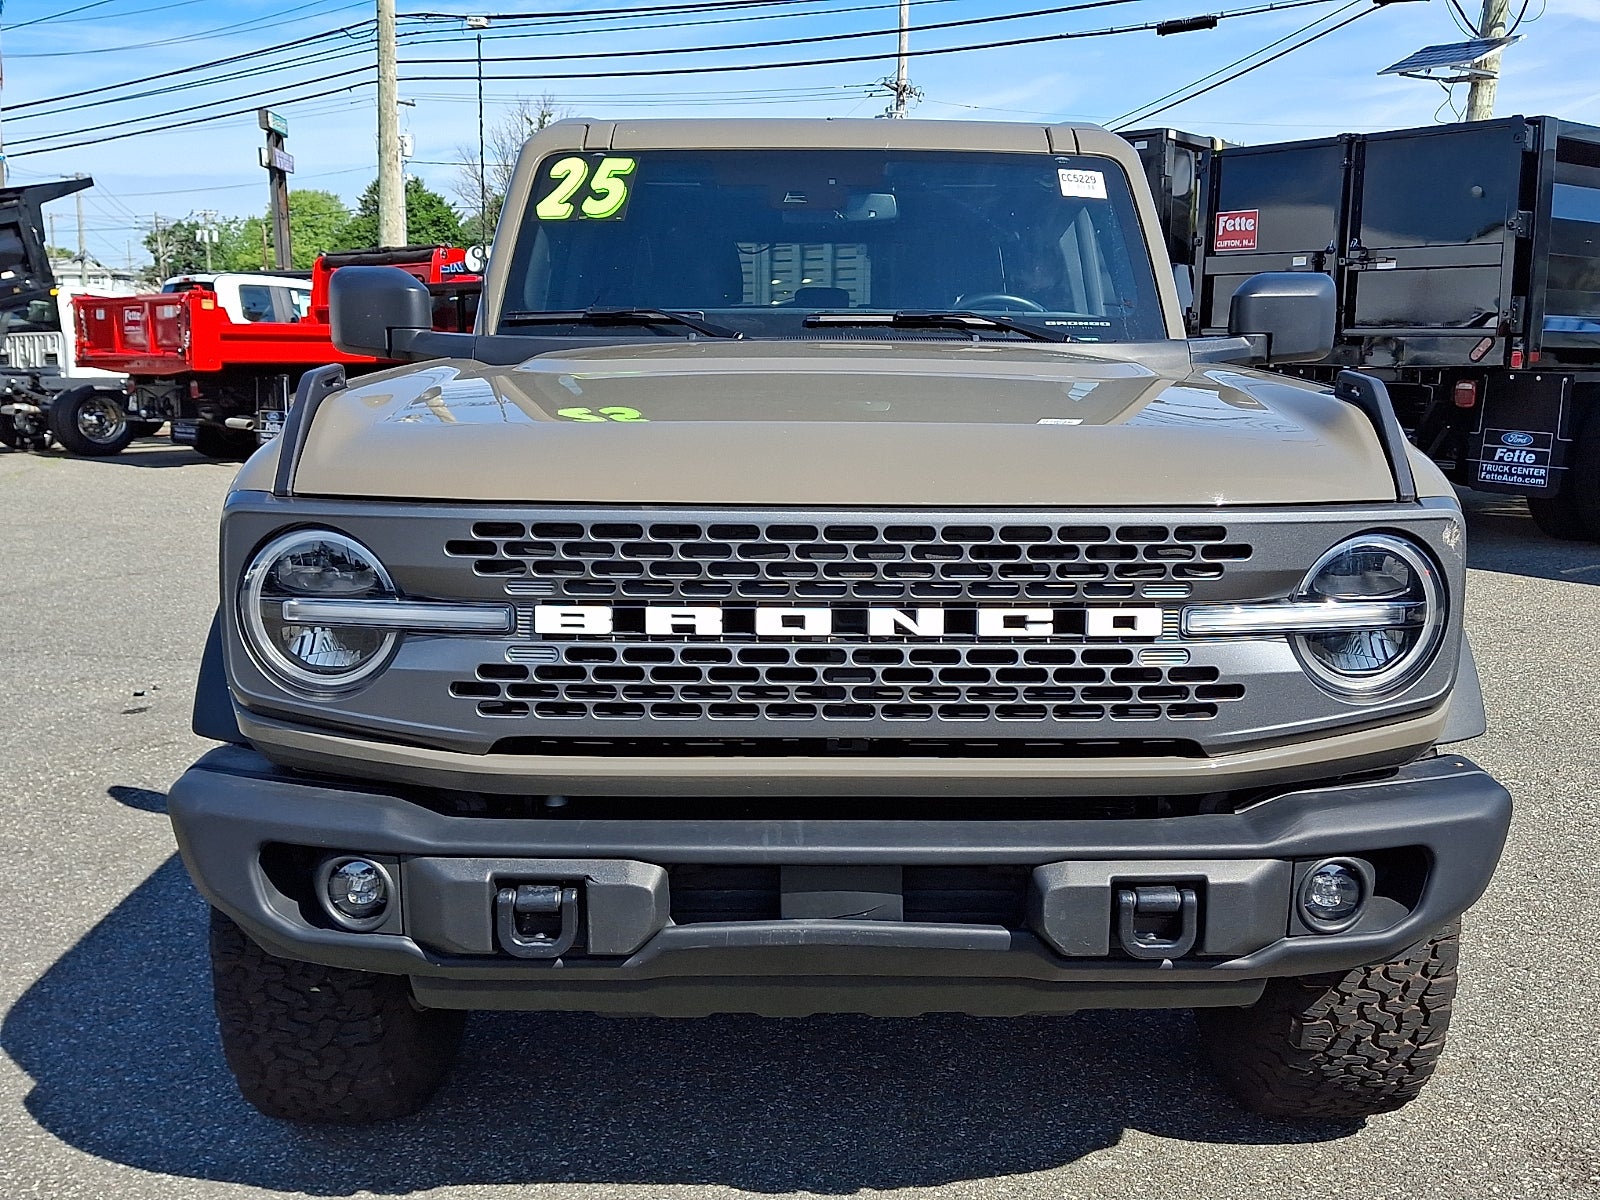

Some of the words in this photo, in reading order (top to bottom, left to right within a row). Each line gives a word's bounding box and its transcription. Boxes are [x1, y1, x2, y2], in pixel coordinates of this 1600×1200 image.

[1061, 173, 1097, 184] CC5229
[536, 156, 636, 220] 25
[1218, 216, 1255, 236] Fette
[1216, 240, 1242, 248] CLIFTON,
[1507, 434, 1528, 444] Ford
[1493, 447, 1536, 464] Fette
[1481, 463, 1510, 473] TRUCK
[1511, 466, 1546, 477] CENTER
[1480, 471, 1545, 485] FetteAuto.com
[534, 605, 1164, 637] BRONCO
